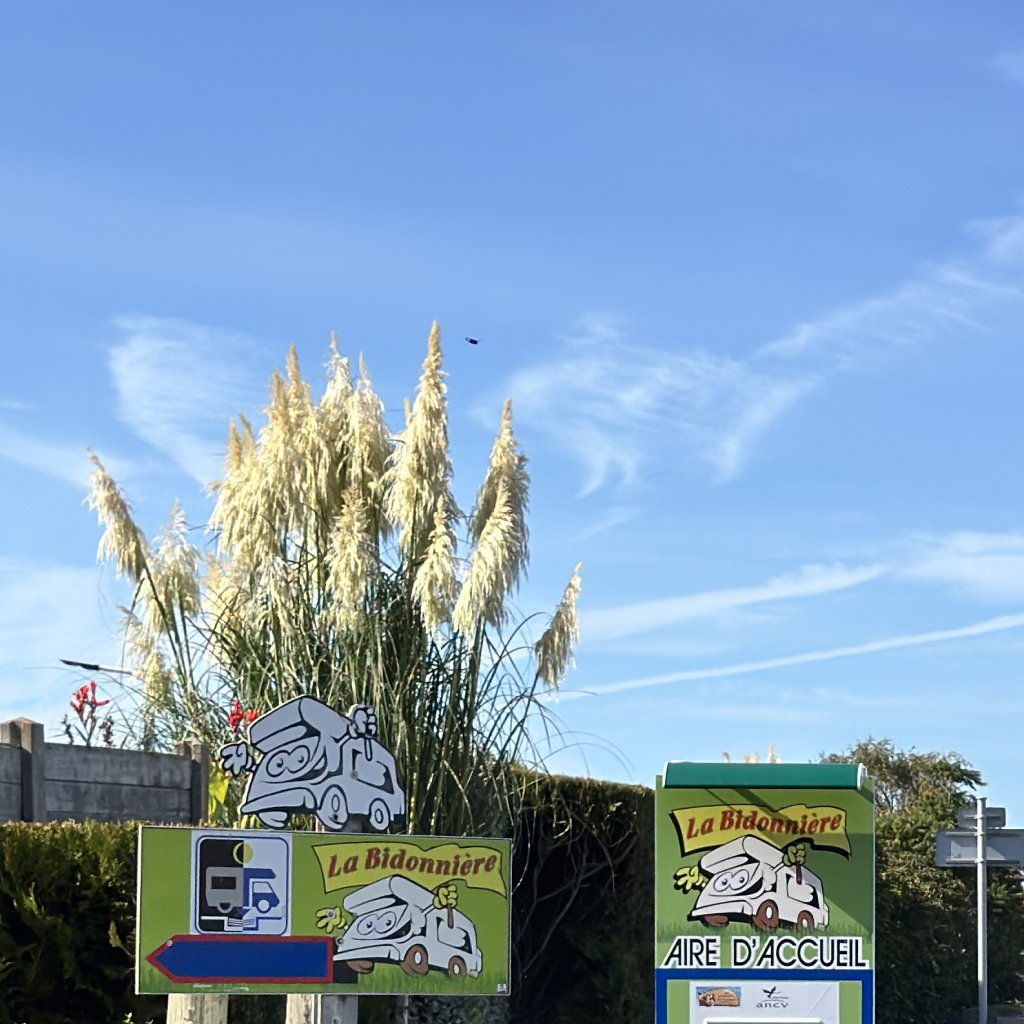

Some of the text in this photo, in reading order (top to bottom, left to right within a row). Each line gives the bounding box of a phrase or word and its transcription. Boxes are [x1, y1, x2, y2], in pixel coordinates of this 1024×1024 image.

[686, 809, 843, 840] La Bidonnière
[328, 847, 498, 879] La Bidonnière
[664, 938, 867, 968] AIRE D'ACCUEIL
